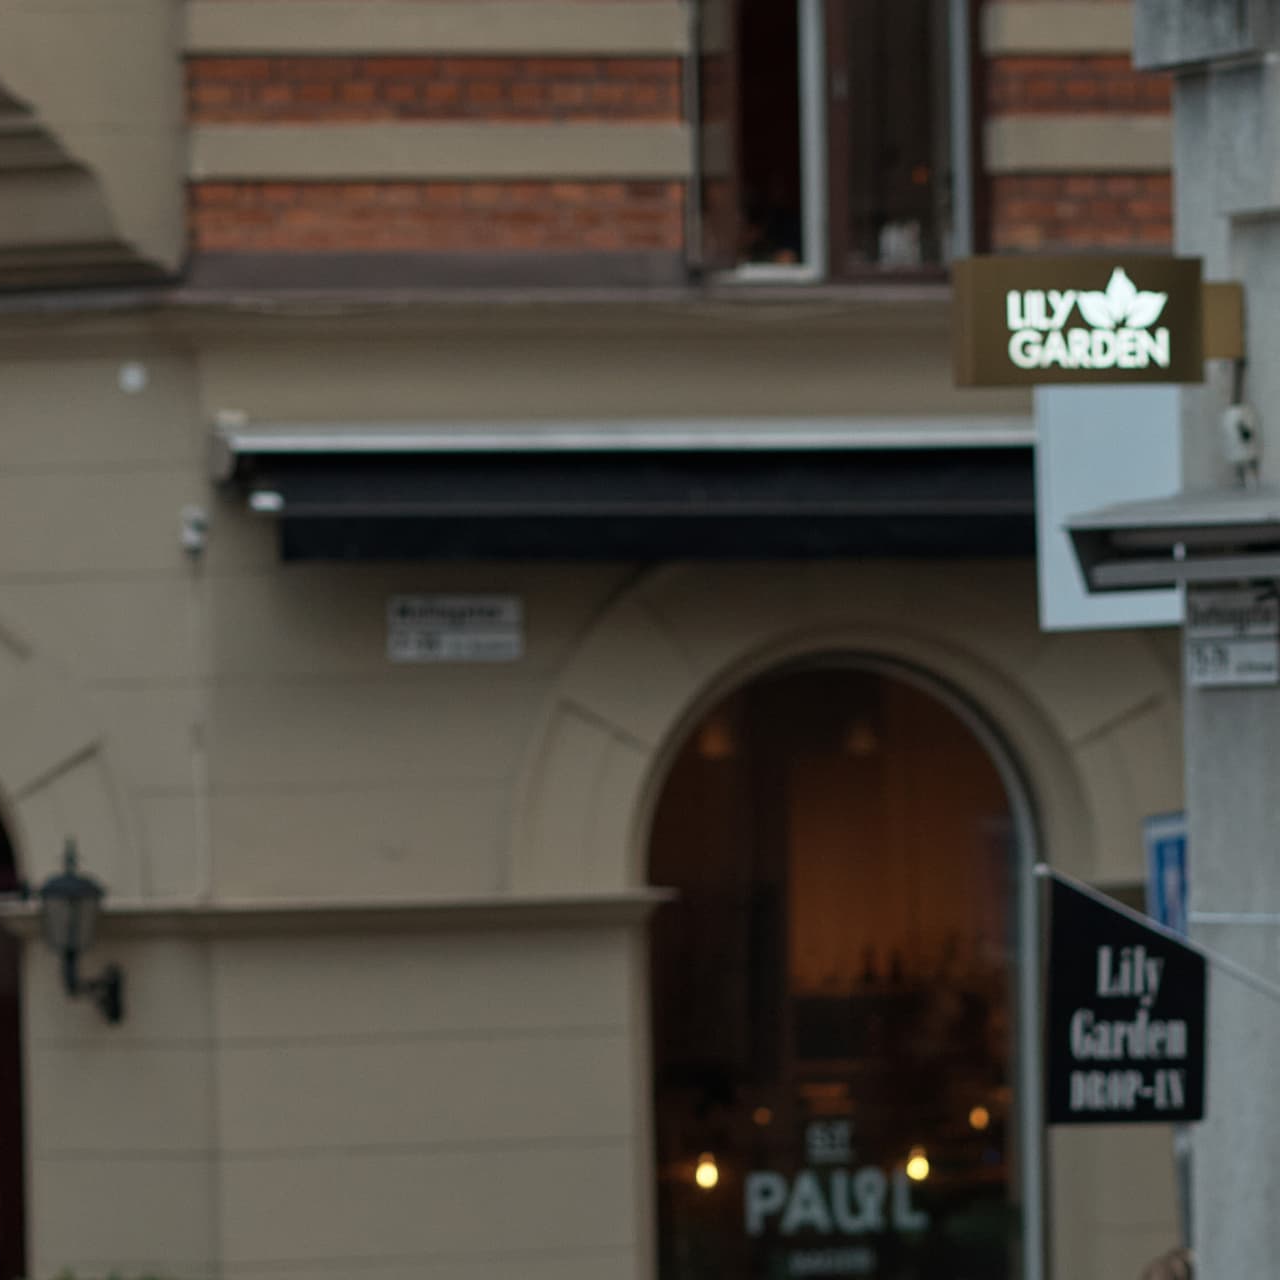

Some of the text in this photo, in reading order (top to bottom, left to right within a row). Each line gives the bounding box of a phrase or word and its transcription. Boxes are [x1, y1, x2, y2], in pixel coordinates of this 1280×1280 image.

[1006, 289, 1078, 331] LILY
[1008, 327, 1170, 368] GARDEN
[1096, 945, 1165, 1007] Lily
[1070, 1007, 1187, 1060] Garden
[1070, 1068, 1186, 1111] DROP-IN
[745, 1166, 929, 1236] PAUL
